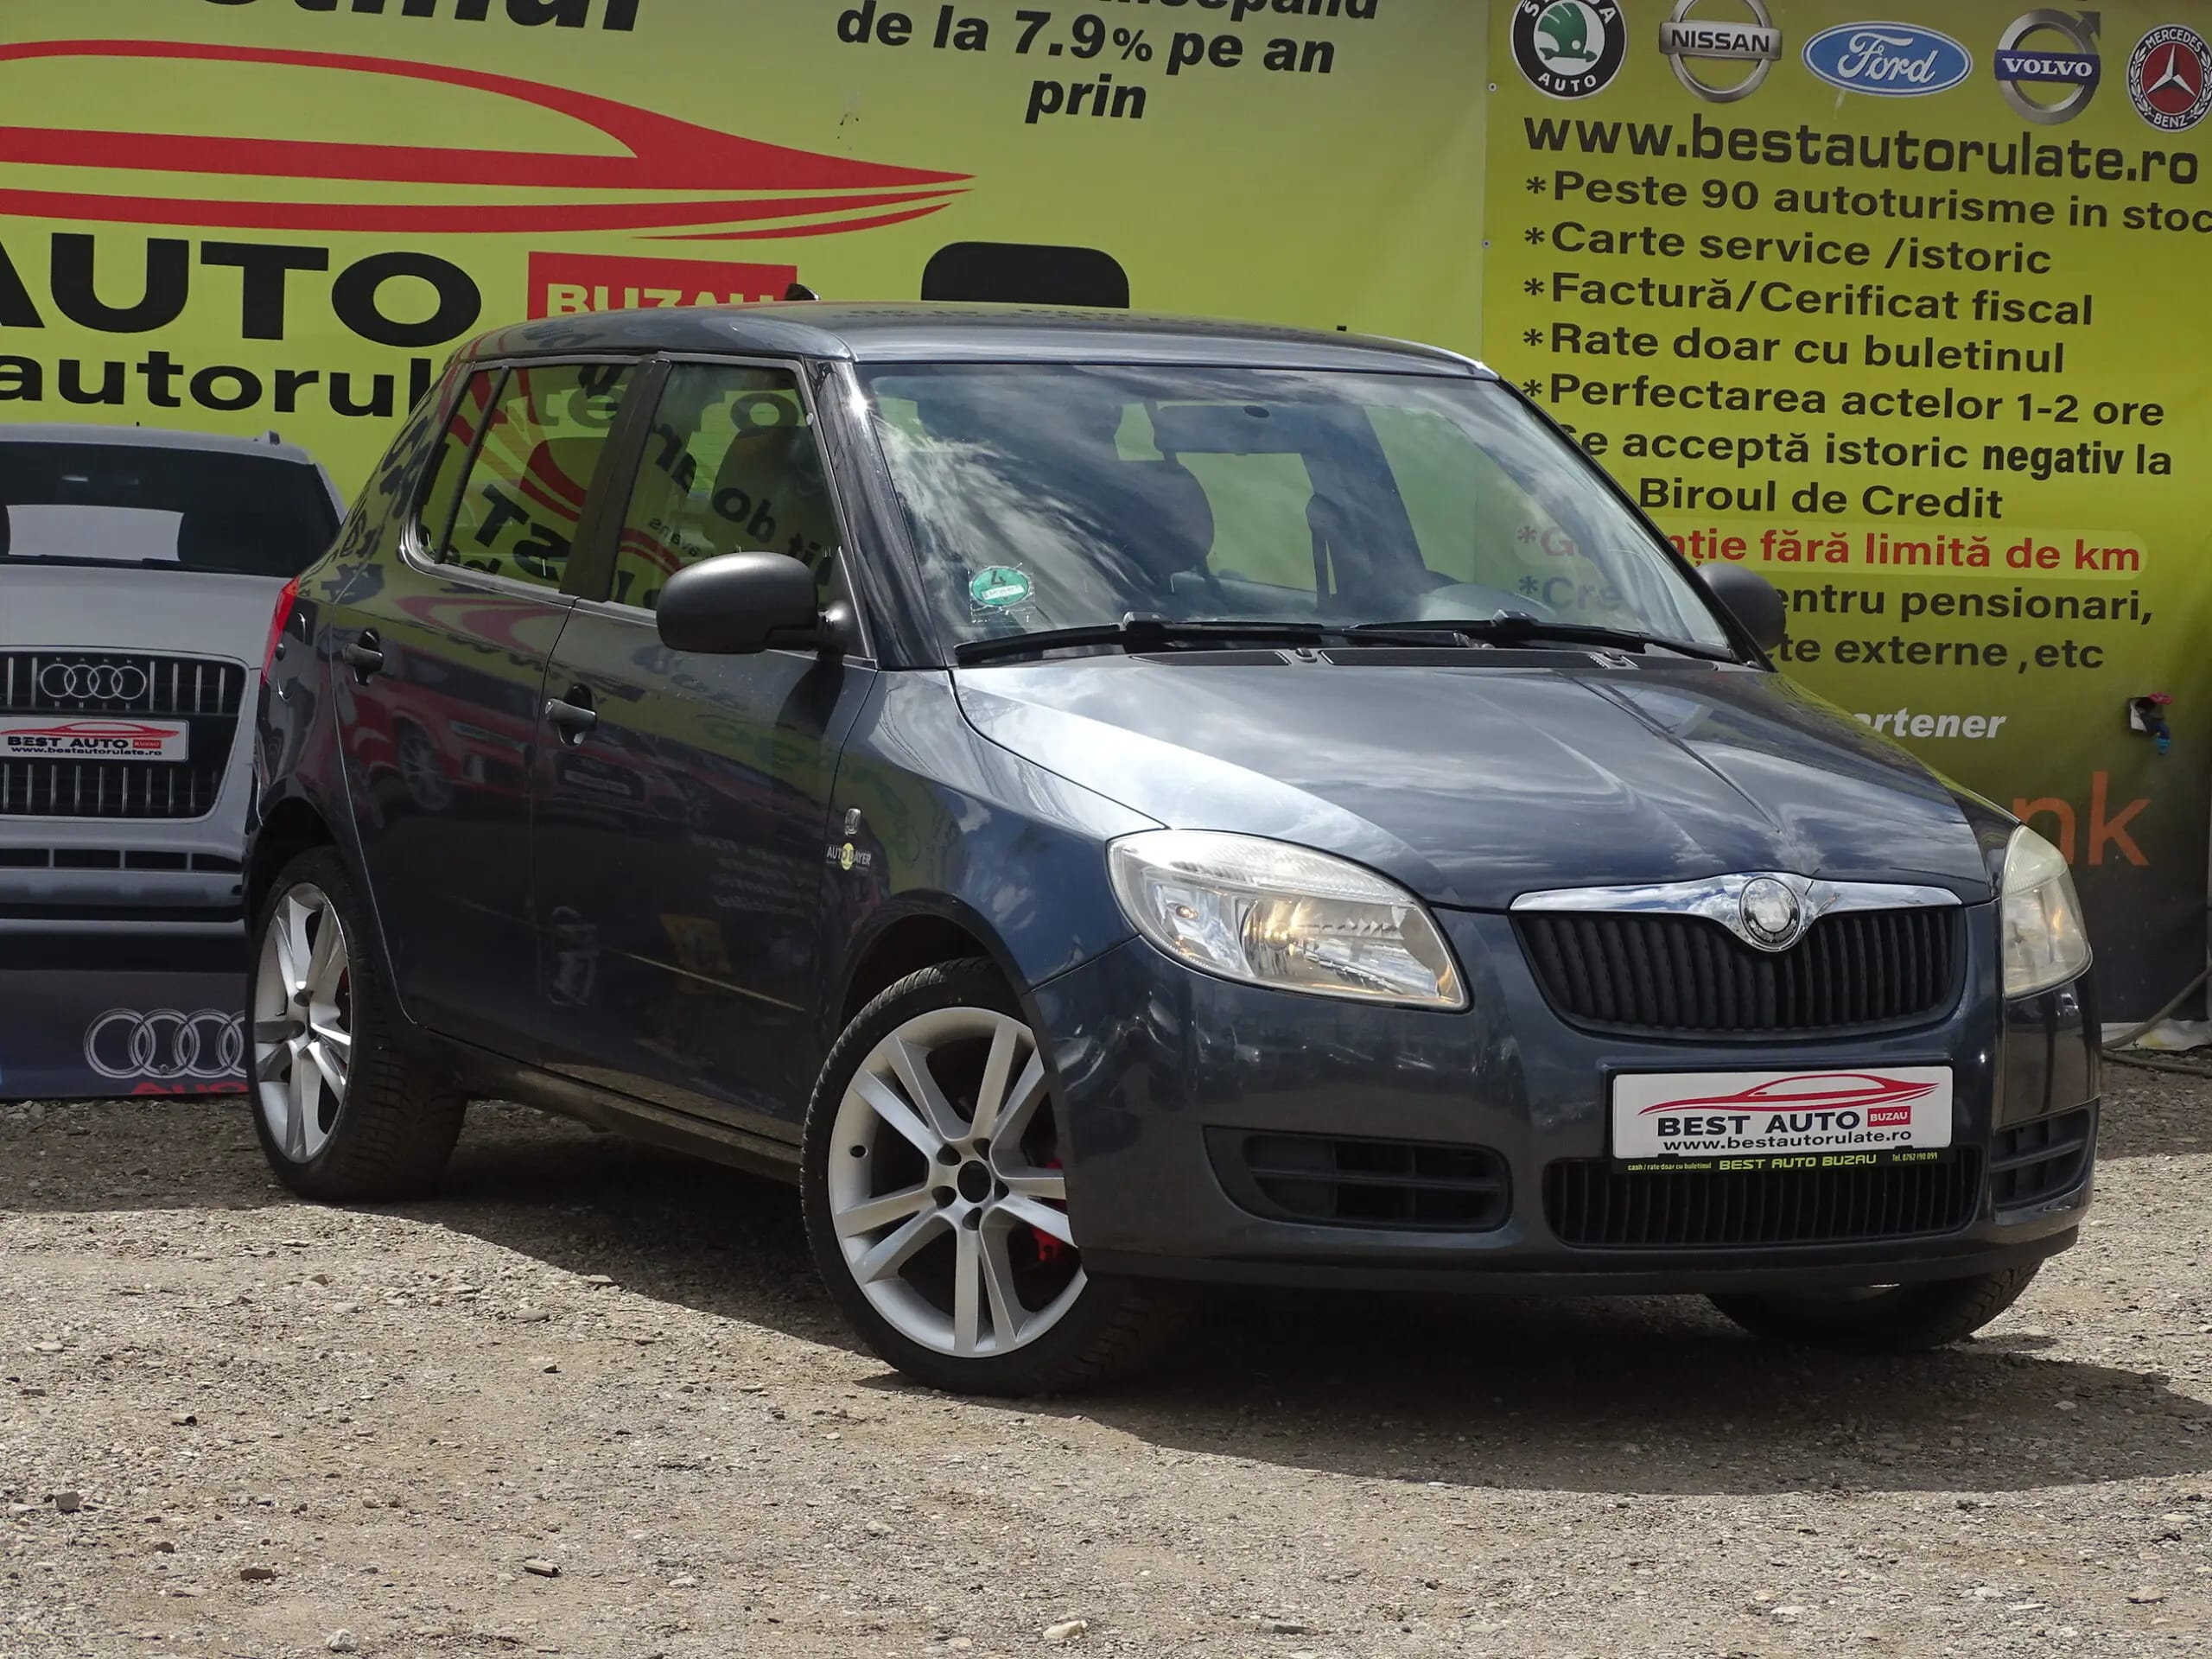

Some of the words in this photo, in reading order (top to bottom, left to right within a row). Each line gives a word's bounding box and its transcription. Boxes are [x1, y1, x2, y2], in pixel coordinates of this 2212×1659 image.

[836, 0, 912, 46] de
[933, 4, 989, 51] la
[1015, 10, 1154, 62] 7.9%
[1166, 31, 1244, 75] pe
[1262, 36, 1335, 73] an
[1671, 29, 1770, 53] NISSAN
[2146, 28, 2203, 53] MERCEDES
[1837, 31, 1940, 84] Ford
[2003, 57, 2094, 78] VOLVO
[1025, 73, 1147, 124] prin
[1538, 72, 1597, 92] AUTO
[2152, 113, 2190, 128] BENZ
[1523, 113, 2198, 185] www.bestautorulate.ro
[1701, 179, 1759, 210] 90
[1774, 186, 2056, 226] autoturisme
[2069, 194, 2108, 227] in
[2122, 201, 2212, 234] stoc
[1699, 232, 1871, 266] service
[1885, 237, 2051, 274] /istoric
[1972, 289, 2093, 326] fiscal
[1673, 327, 1780, 362] doar
[1794, 340, 1848, 365] cu
[1865, 334, 2064, 373] buletinul
[1841, 387, 2003, 420] actelor
[2017, 392, 2079, 423] 1-2
[2093, 398, 2164, 426] ore
[1623, 432, 1809, 468] acceptă
[1826, 432, 1968, 467] istoric
[1983, 440, 2124, 481] negativ
[2137, 442, 2171, 475] la
[1641, 476, 1777, 512] Biroul
[1791, 481, 1848, 514] de
[1862, 485, 2003, 519] Credit
[1760, 528, 1850, 563] fără
[1865, 531, 1990, 569] limită
[2005, 537, 2061, 569] de
[2075, 538, 2140, 571] km
[1901, 586, 2152, 626] pensionari,
[1834, 636, 2008, 667] externe
[8, 736, 62, 747] BEST
[69, 737, 130, 749] AUTO
[11, 747, 162, 757] www.bestautorulate.ro
[2012, 771, 2152, 868] nk
[1657, 1116, 1751, 1137] BEST
[1765, 1110, 1860, 1134] AUTO
[1869, 1111, 1908, 1122] BUZAU
[1663, 1129, 1912, 1151] www.bestautorulate.ro
[1719, 1159, 1766, 1171] BEST
[1771, 1156, 1816, 1169] AUTO
[1821, 1154, 1878, 1166] BUZAU
